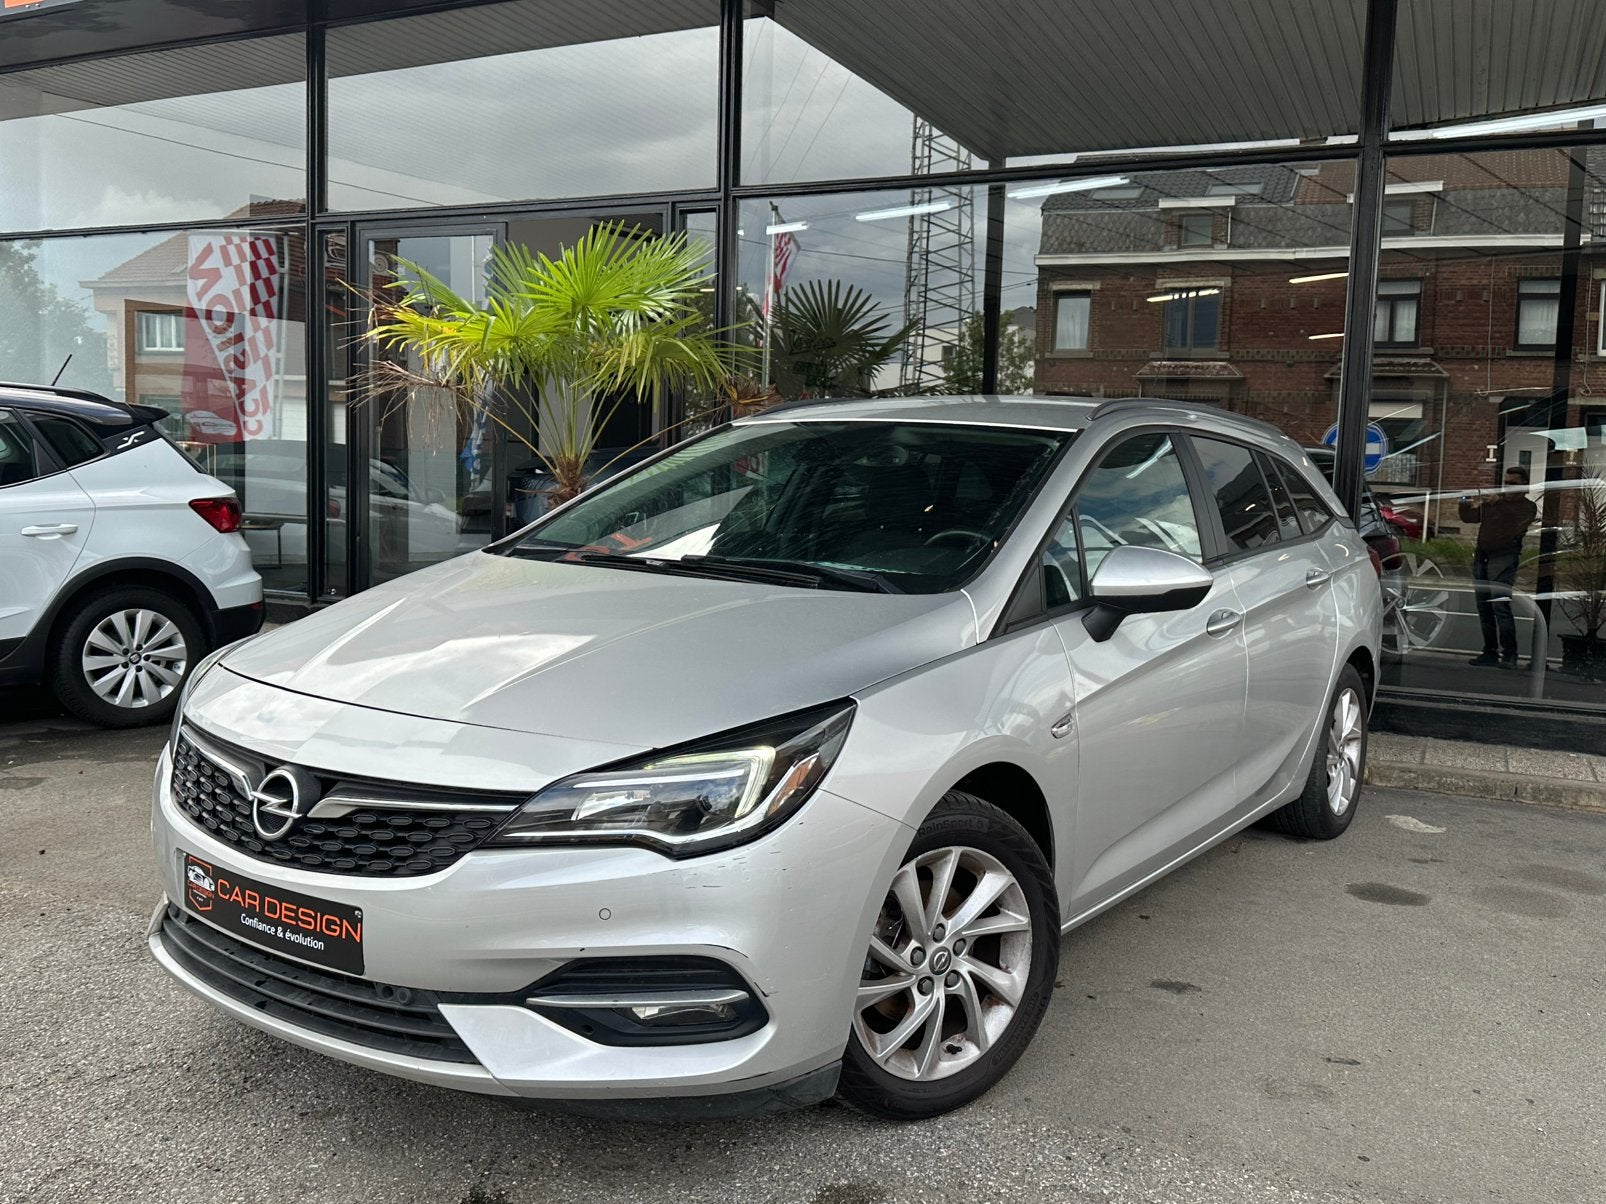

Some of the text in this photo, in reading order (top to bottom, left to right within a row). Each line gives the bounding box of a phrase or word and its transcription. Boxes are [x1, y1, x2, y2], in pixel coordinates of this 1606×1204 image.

[217, 878, 260, 912] CAR
[264, 896, 361, 943] DESIGN
[240, 913, 324, 950] Confiance & évolution
